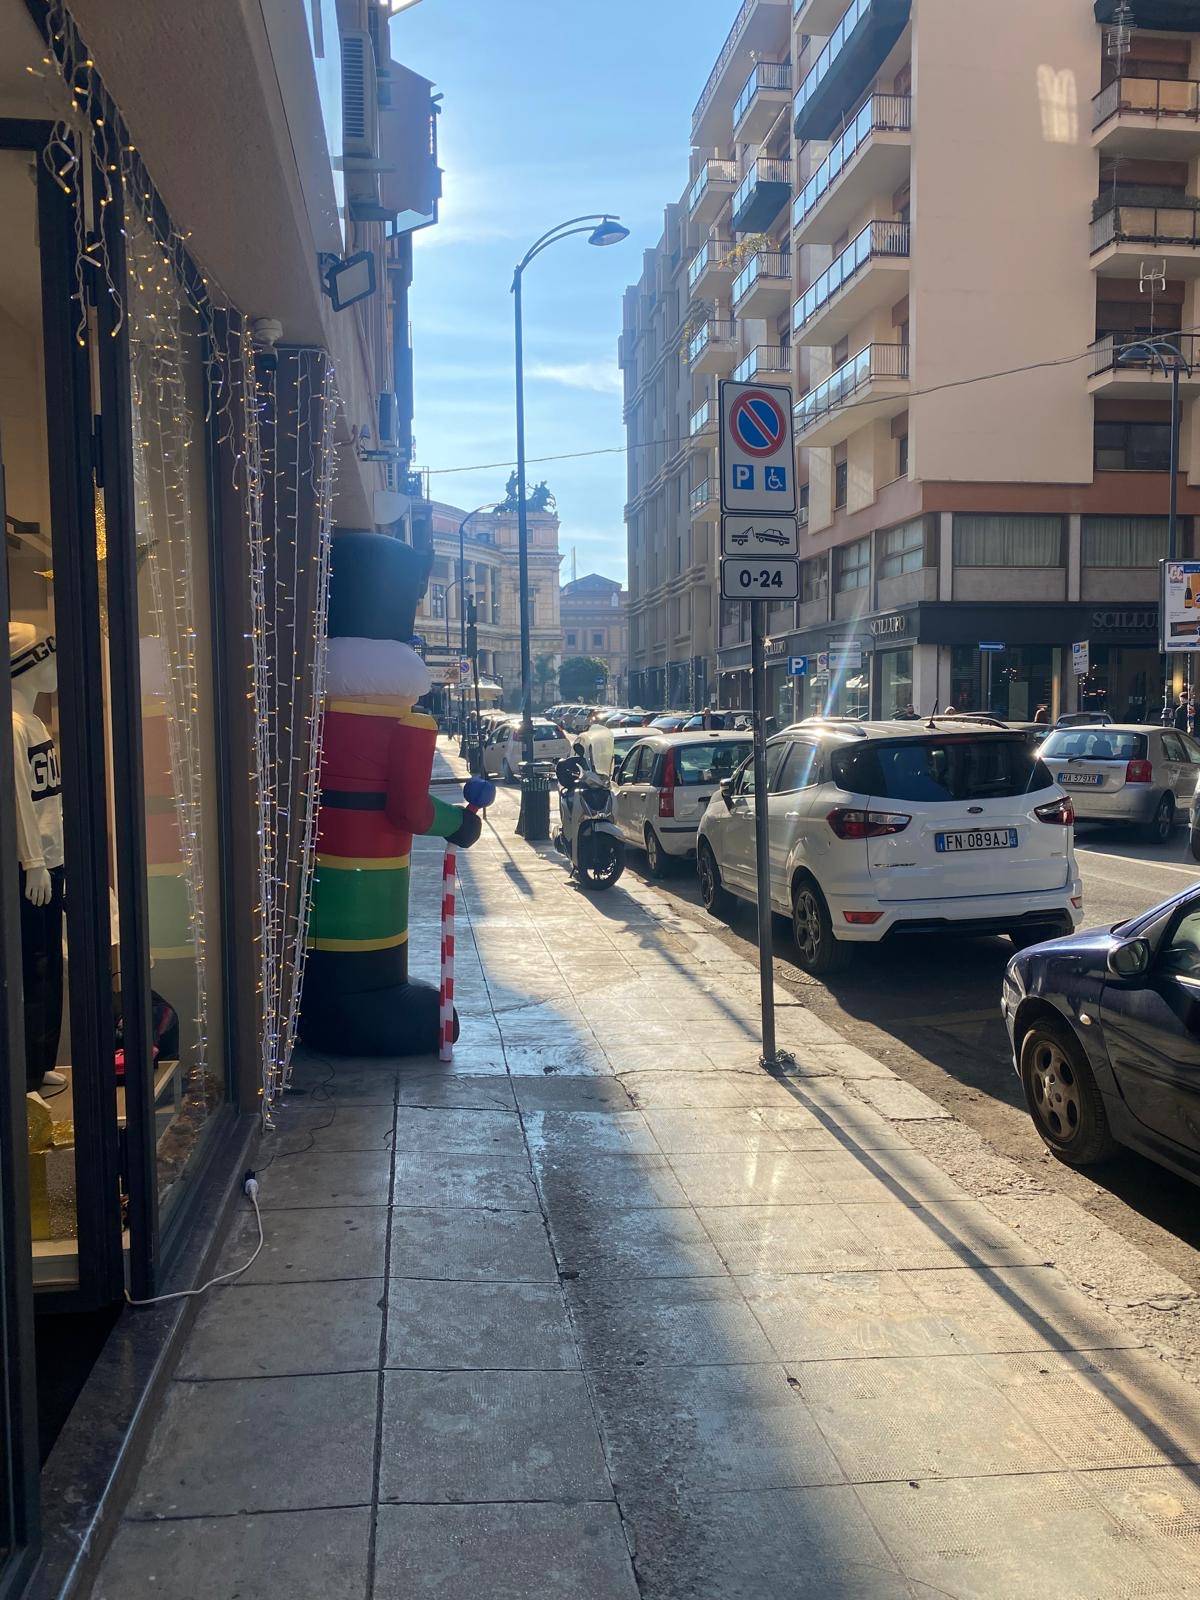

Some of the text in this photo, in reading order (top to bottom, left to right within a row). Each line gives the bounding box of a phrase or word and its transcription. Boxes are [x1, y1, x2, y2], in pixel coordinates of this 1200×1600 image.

[737, 466, 750, 488] P
[739, 569, 784, 589] 0-24
[791, 657, 804, 674] P
